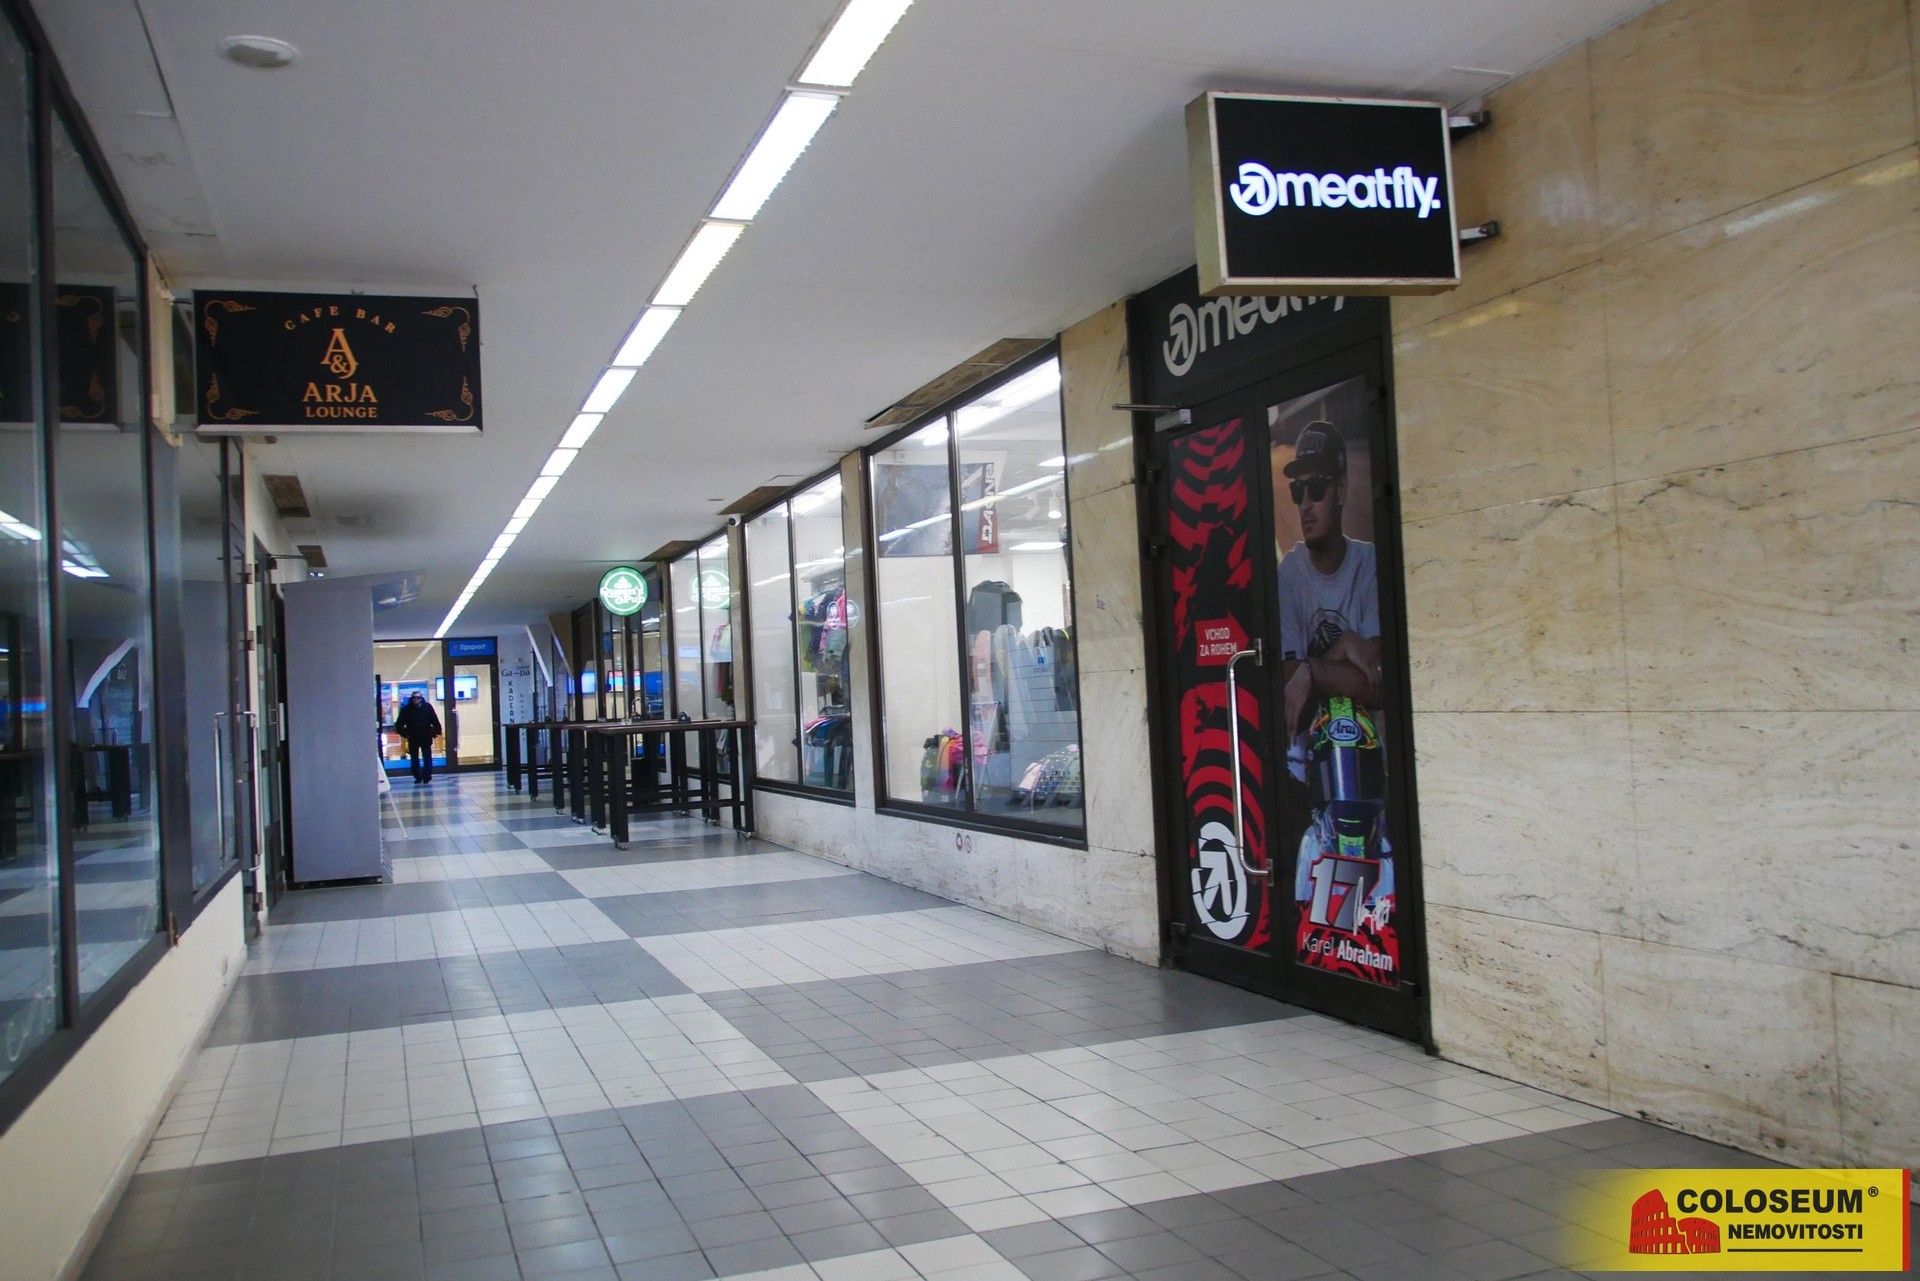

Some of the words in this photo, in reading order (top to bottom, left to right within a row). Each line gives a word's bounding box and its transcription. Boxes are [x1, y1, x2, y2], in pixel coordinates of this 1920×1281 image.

[283, 305, 339, 331] CAFE
[355, 307, 396, 333] BAR
[303, 382, 378, 403] ARJA
[306, 406, 378, 418] LOUNGE
[1205, 627, 1230, 640] VCHOD
[1200, 644, 1209, 656] ZA
[1210, 642, 1237, 655] ROHEM
[1309, 856, 1380, 932] 17
[1302, 932, 1335, 956] Karel
[1337, 939, 1393, 971] Abraham
